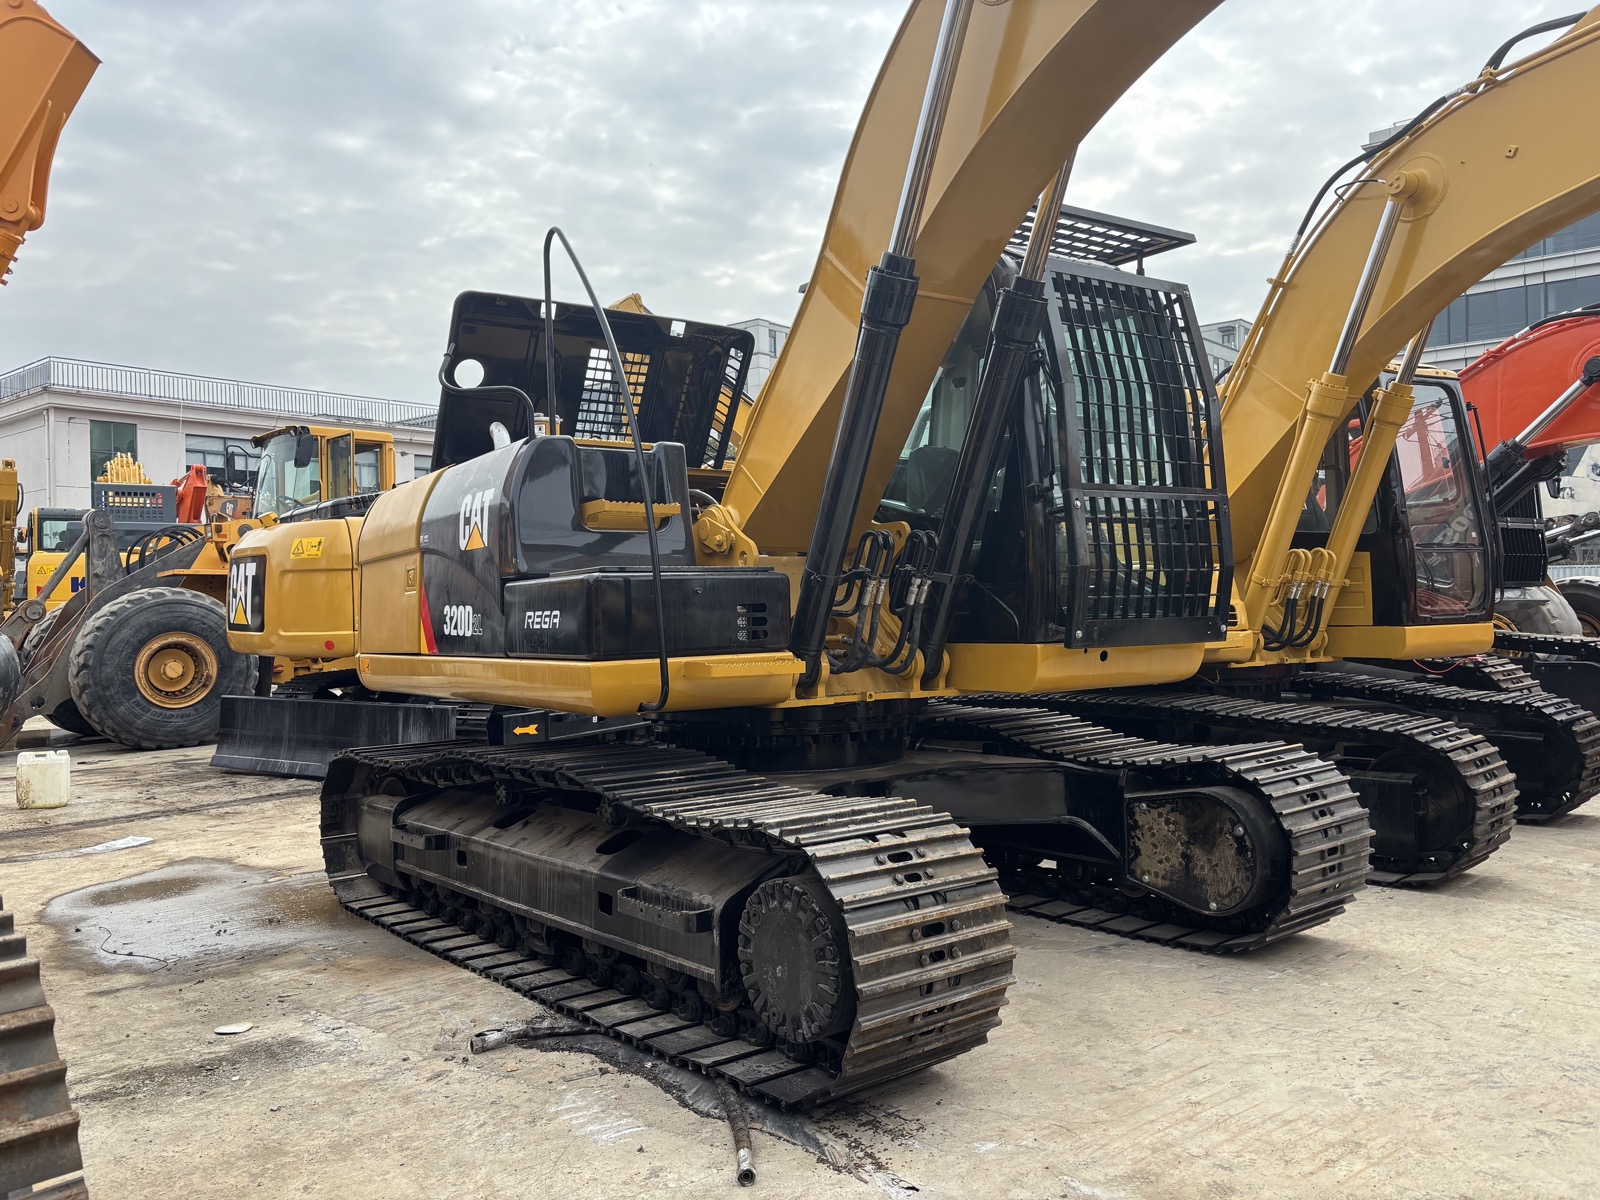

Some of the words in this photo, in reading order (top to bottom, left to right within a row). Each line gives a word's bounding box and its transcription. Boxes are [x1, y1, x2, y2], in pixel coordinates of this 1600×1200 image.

[459, 488, 495, 551] CAT
[229, 562, 257, 625] CAT
[524, 610, 561, 629] REGA
